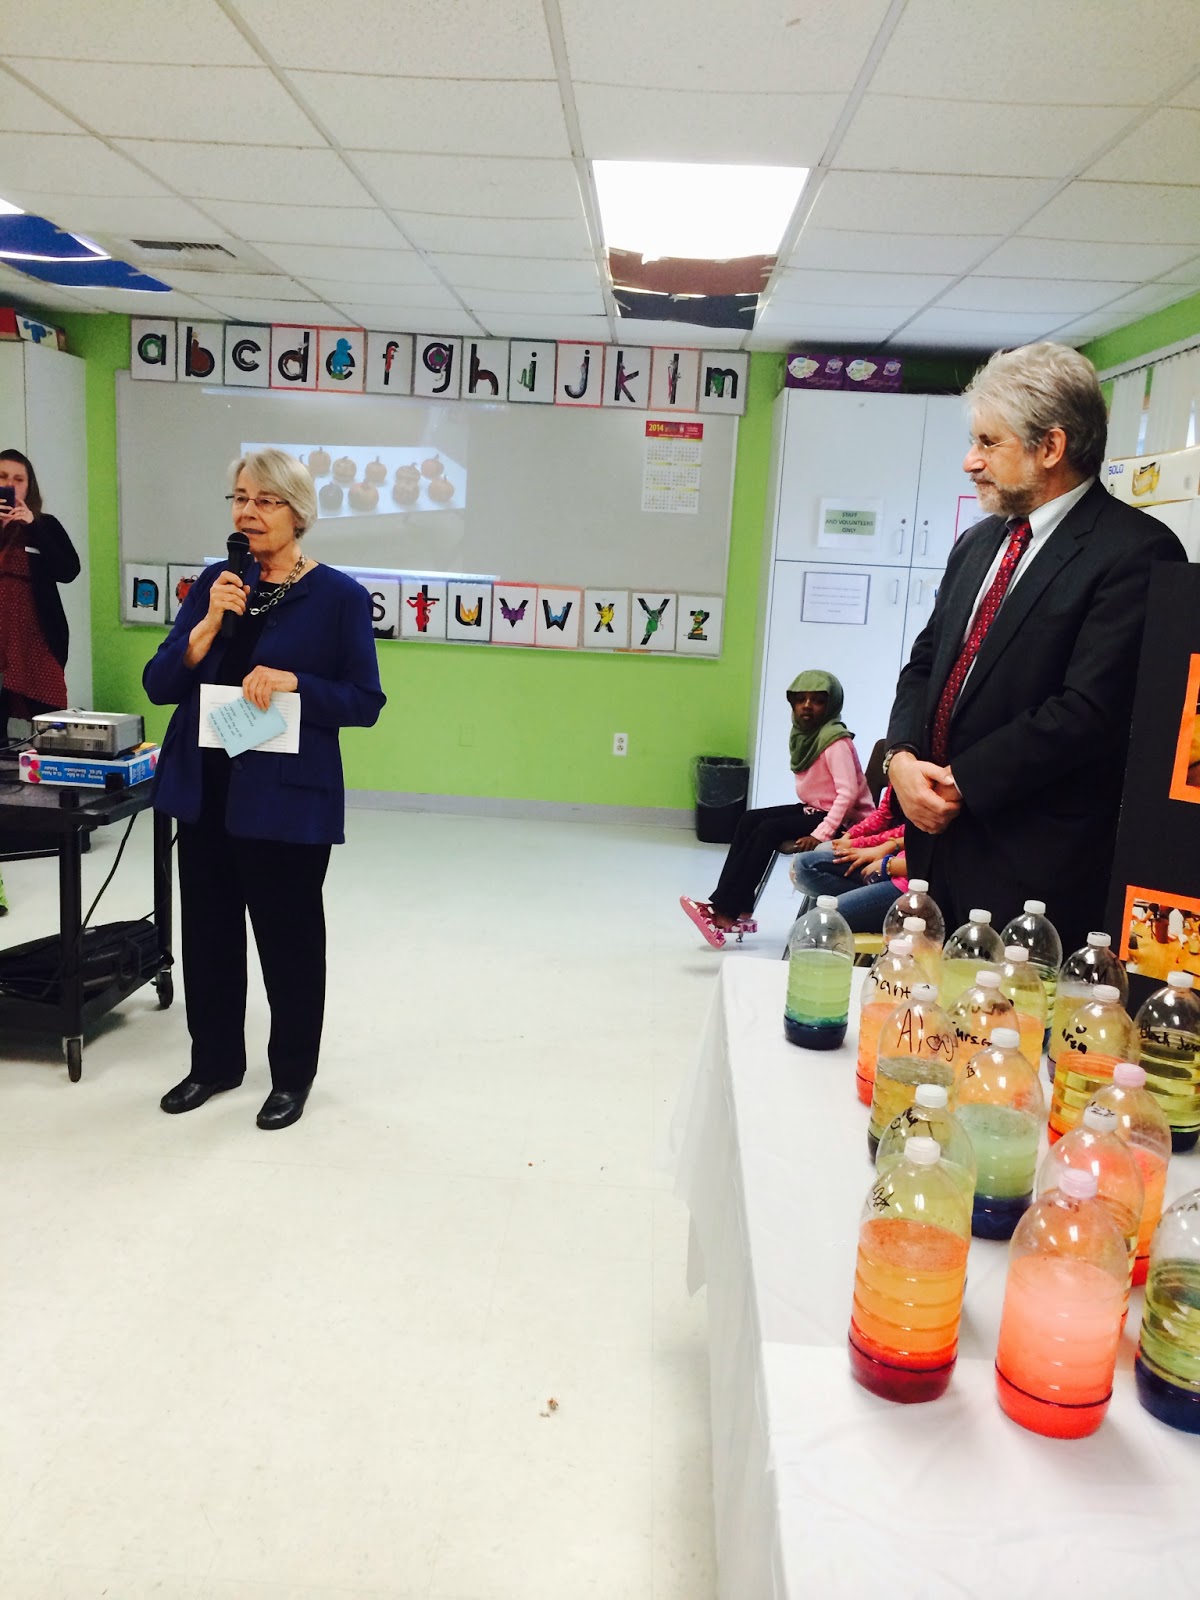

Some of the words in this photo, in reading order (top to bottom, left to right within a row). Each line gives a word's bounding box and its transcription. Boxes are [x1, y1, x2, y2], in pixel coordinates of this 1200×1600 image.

[137, 333, 167, 366] a
[185, 326, 215, 378] b
[232, 339, 262, 372] c
[278, 332, 310, 383] d
[382, 341, 400, 385] f
[422, 342, 454, 394] g
[468, 343, 499, 396] h
[564, 349, 590, 399] j
[614, 351, 639, 403] k
[705, 366, 739, 400] m
[648, 423, 665, 432] 2014
[1108, 464, 1124, 476] SOLO
[132, 577, 159, 611] n
[409, 584, 440, 633] t
[455, 595, 483, 627] u
[498, 598, 529, 628] v
[542, 599, 573, 631] w
[593, 602, 615, 633] x
[637, 598, 670, 645] y
[687, 609, 711, 641] z
